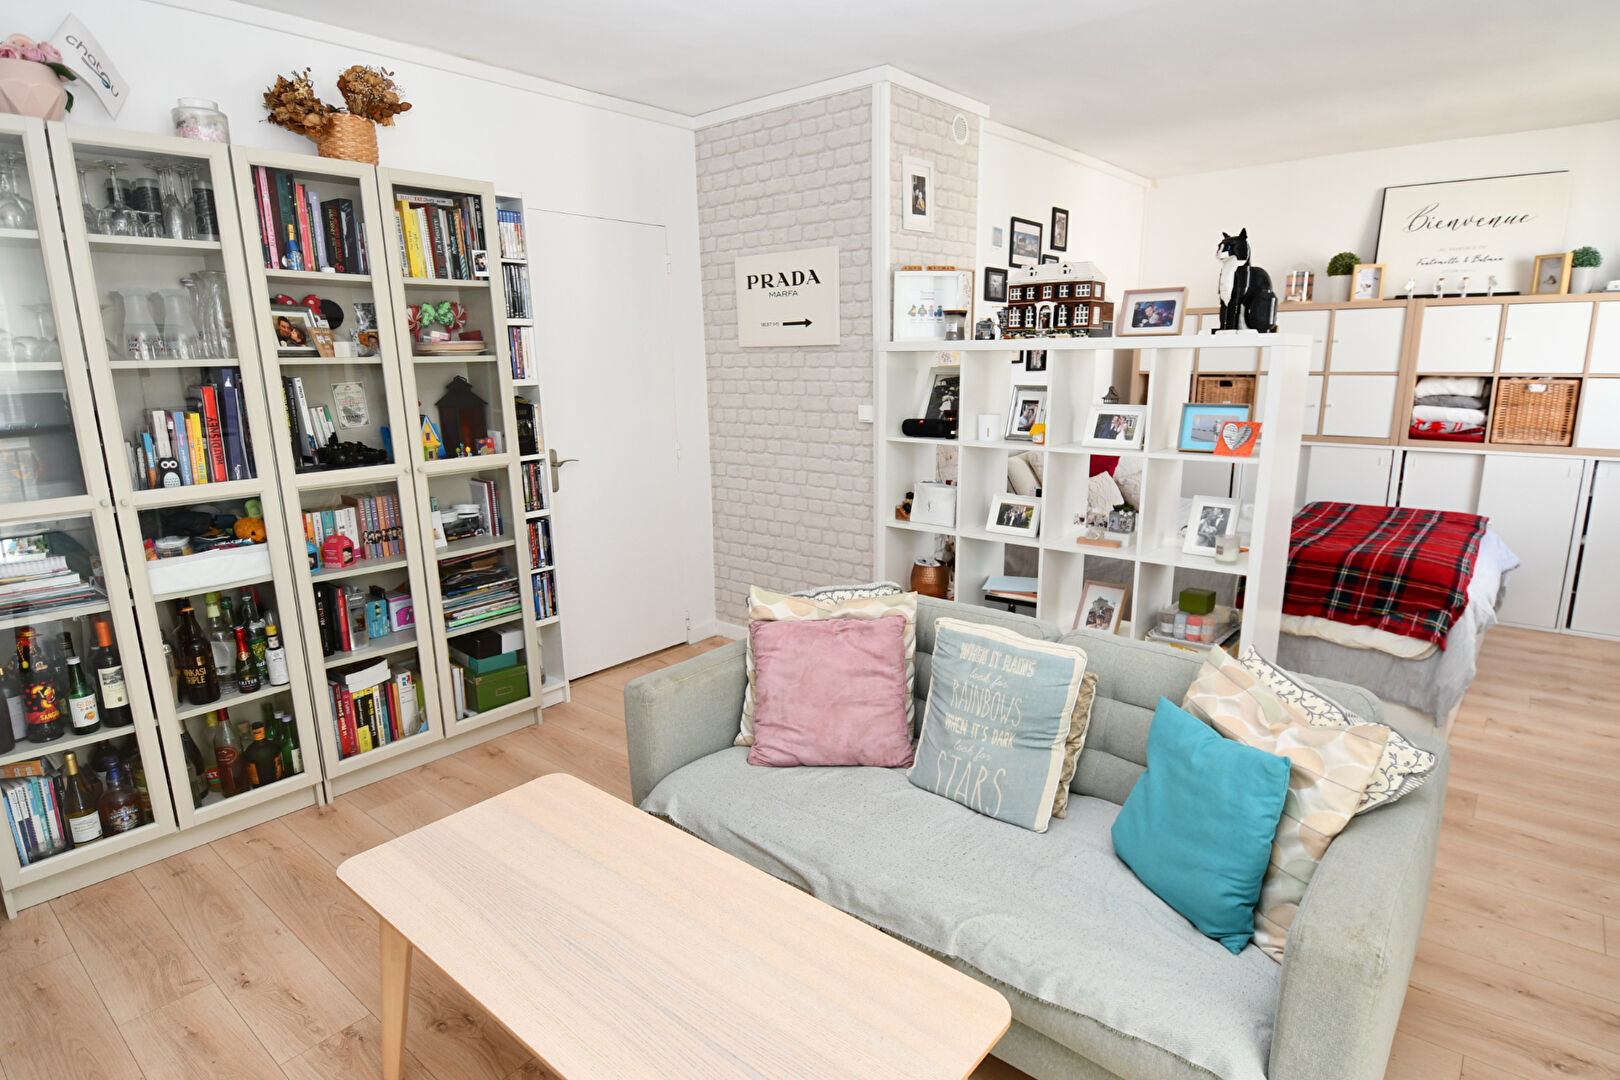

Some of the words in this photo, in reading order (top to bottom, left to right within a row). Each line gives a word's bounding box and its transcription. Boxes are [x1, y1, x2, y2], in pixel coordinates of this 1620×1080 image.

[65, 34, 119, 98] chatou
[1402, 202, 1537, 233] Bienvenue
[746, 269, 821, 290] PRADA
[768, 290, 799, 298] MARFA
[959, 642, 987, 666] WHEN
[988, 652, 1003, 670] IT
[1002, 654, 1038, 678] RAINS
[950, 680, 1023, 727] RAINBOWS
[945, 713, 968, 736] WHEN
[970, 723, 989, 743] IT'S
[991, 727, 1016, 749] DARK
[935, 750, 1007, 818] STARS
